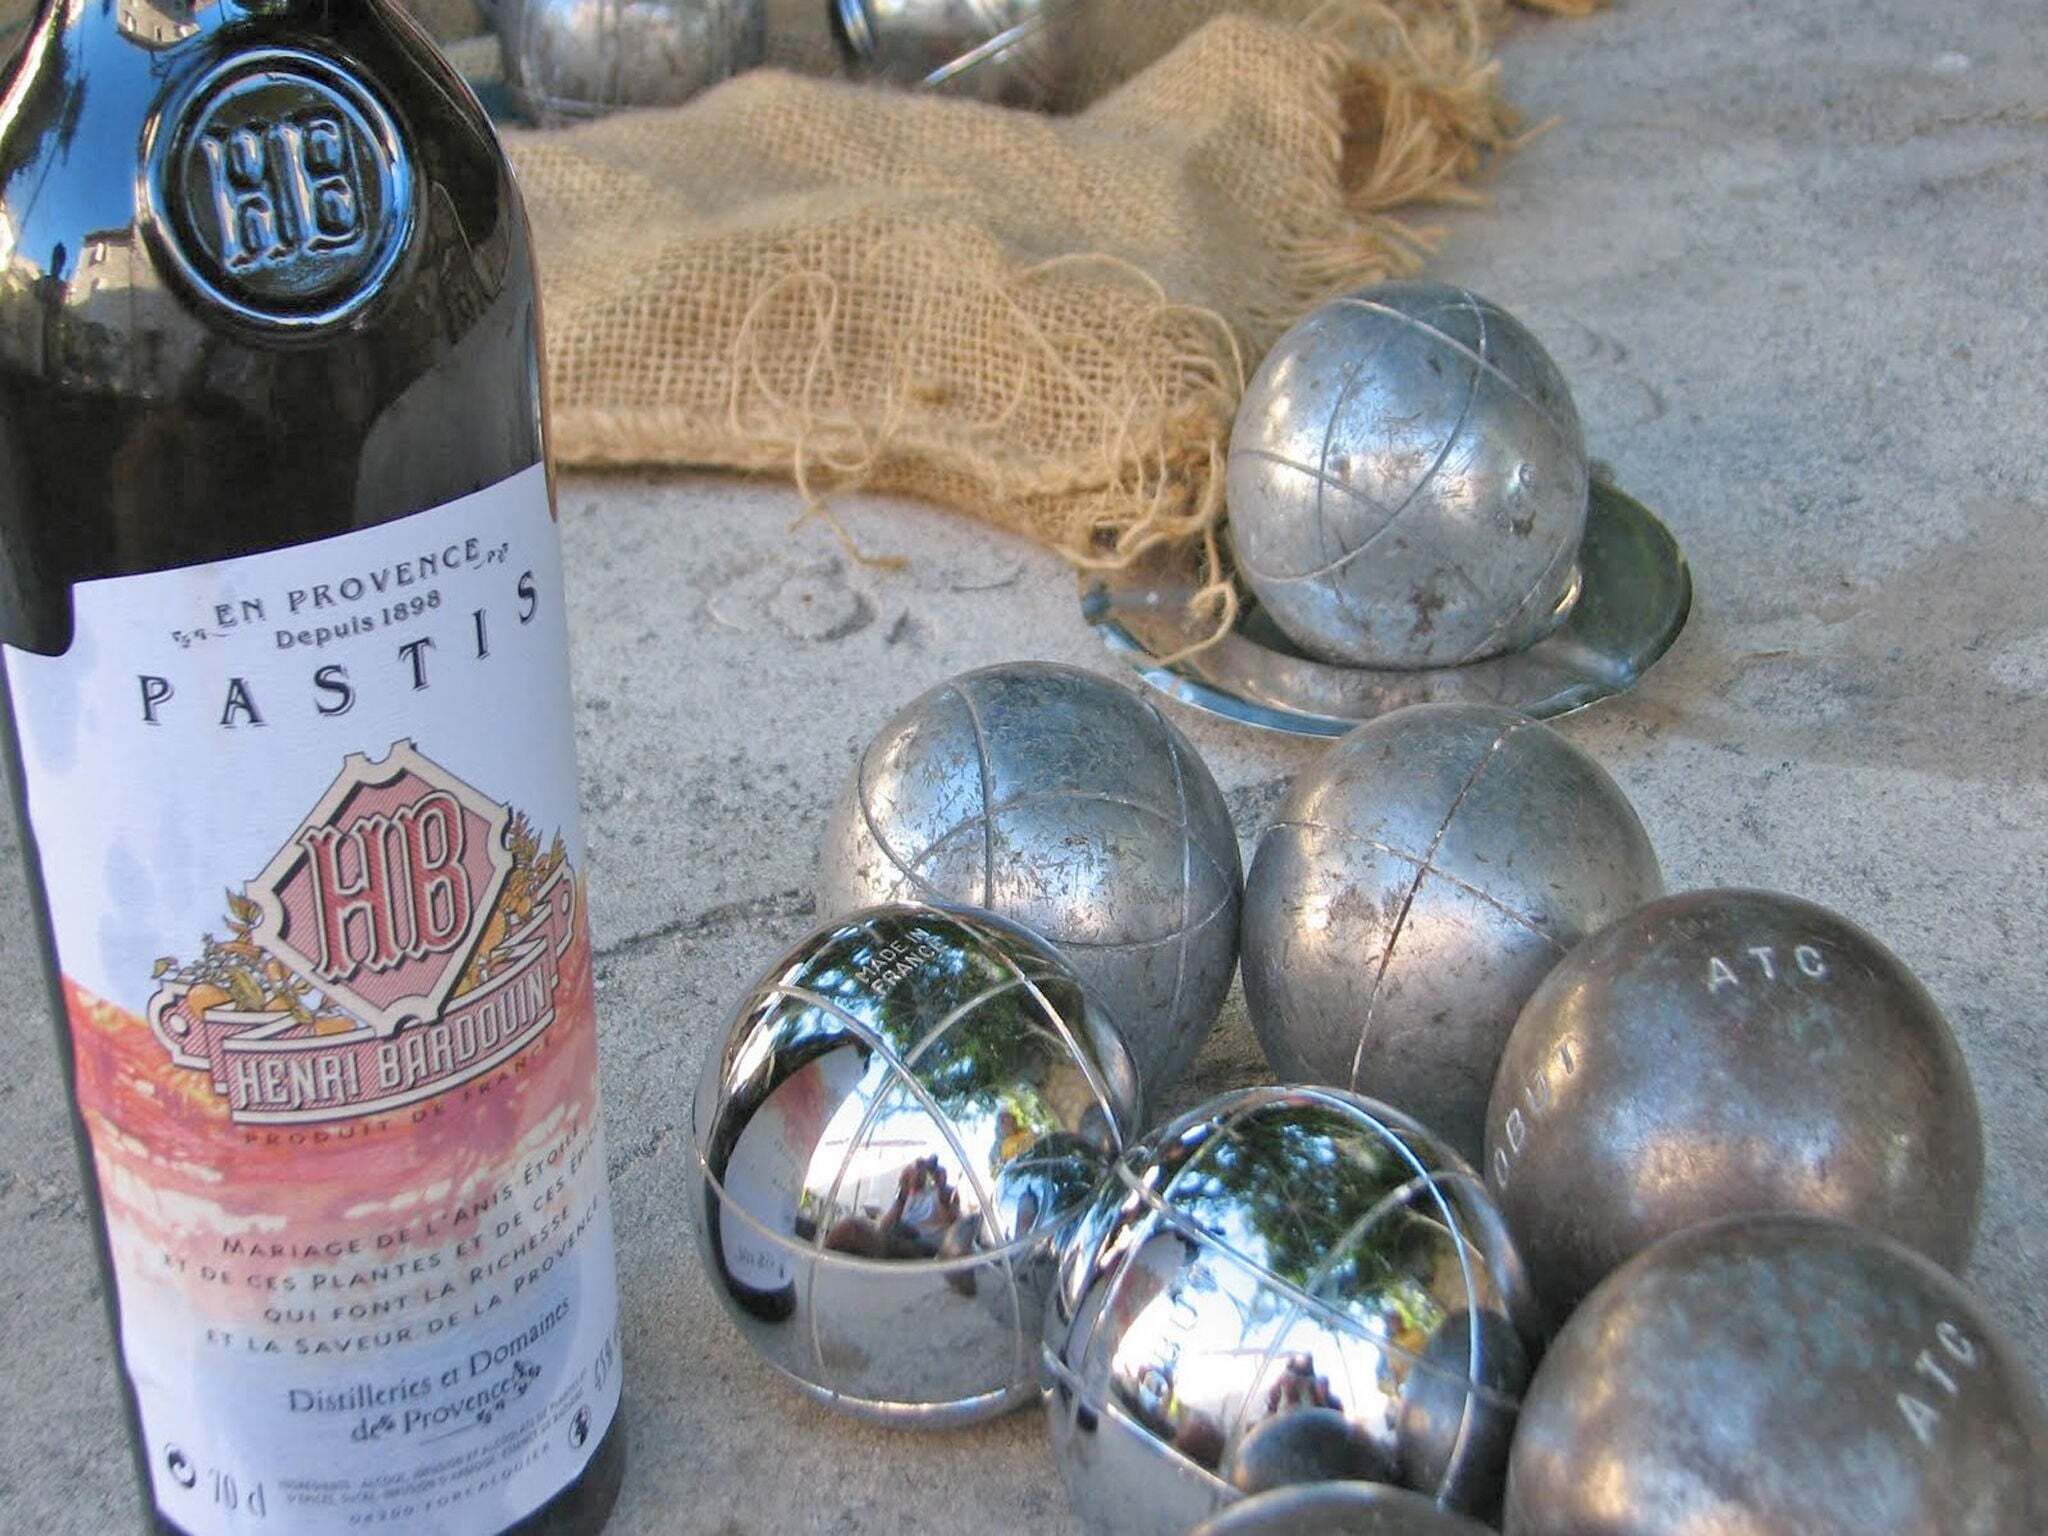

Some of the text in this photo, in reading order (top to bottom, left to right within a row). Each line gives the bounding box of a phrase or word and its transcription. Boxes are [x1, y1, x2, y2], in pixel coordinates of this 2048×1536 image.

[214, 537, 482, 629] EN PROVENCE
[275, 590, 442, 649] Depuis 1898
[138, 570, 538, 729] PASTIS
[300, 790, 473, 982] HB
[855, 927, 929, 984] MADE IN
[1707, 943, 1826, 994] ATC
[235, 965, 552, 1109] HENRI BARDOUIN
[245, 1120, 389, 1144] PRODUIT
[201, 1266, 232, 1284] DE
[247, 1272, 296, 1291] CES
[312, 1253, 441, 1290] PLANTES
[456, 1234, 483, 1257] ET
[496, 1211, 522, 1238] DE
[533, 1177, 564, 1212] CES
[223, 1237, 360, 1258] MARIAGE
[377, 1229, 410, 1249] DE
[264, 1205, 569, 1324] QUI FONT LA RICHESSE
[248, 1337, 280, 1352] LA
[296, 1328, 411, 1355] SAVEUR
[428, 1311, 461, 1334] DE
[473, 1294, 502, 1317] LA
[289, 1376, 431, 1412] Distilleries
[441, 1366, 459, 1388] et
[470, 1297, 570, 1377] Domaines
[1897, 1316, 1976, 1448] ATC
